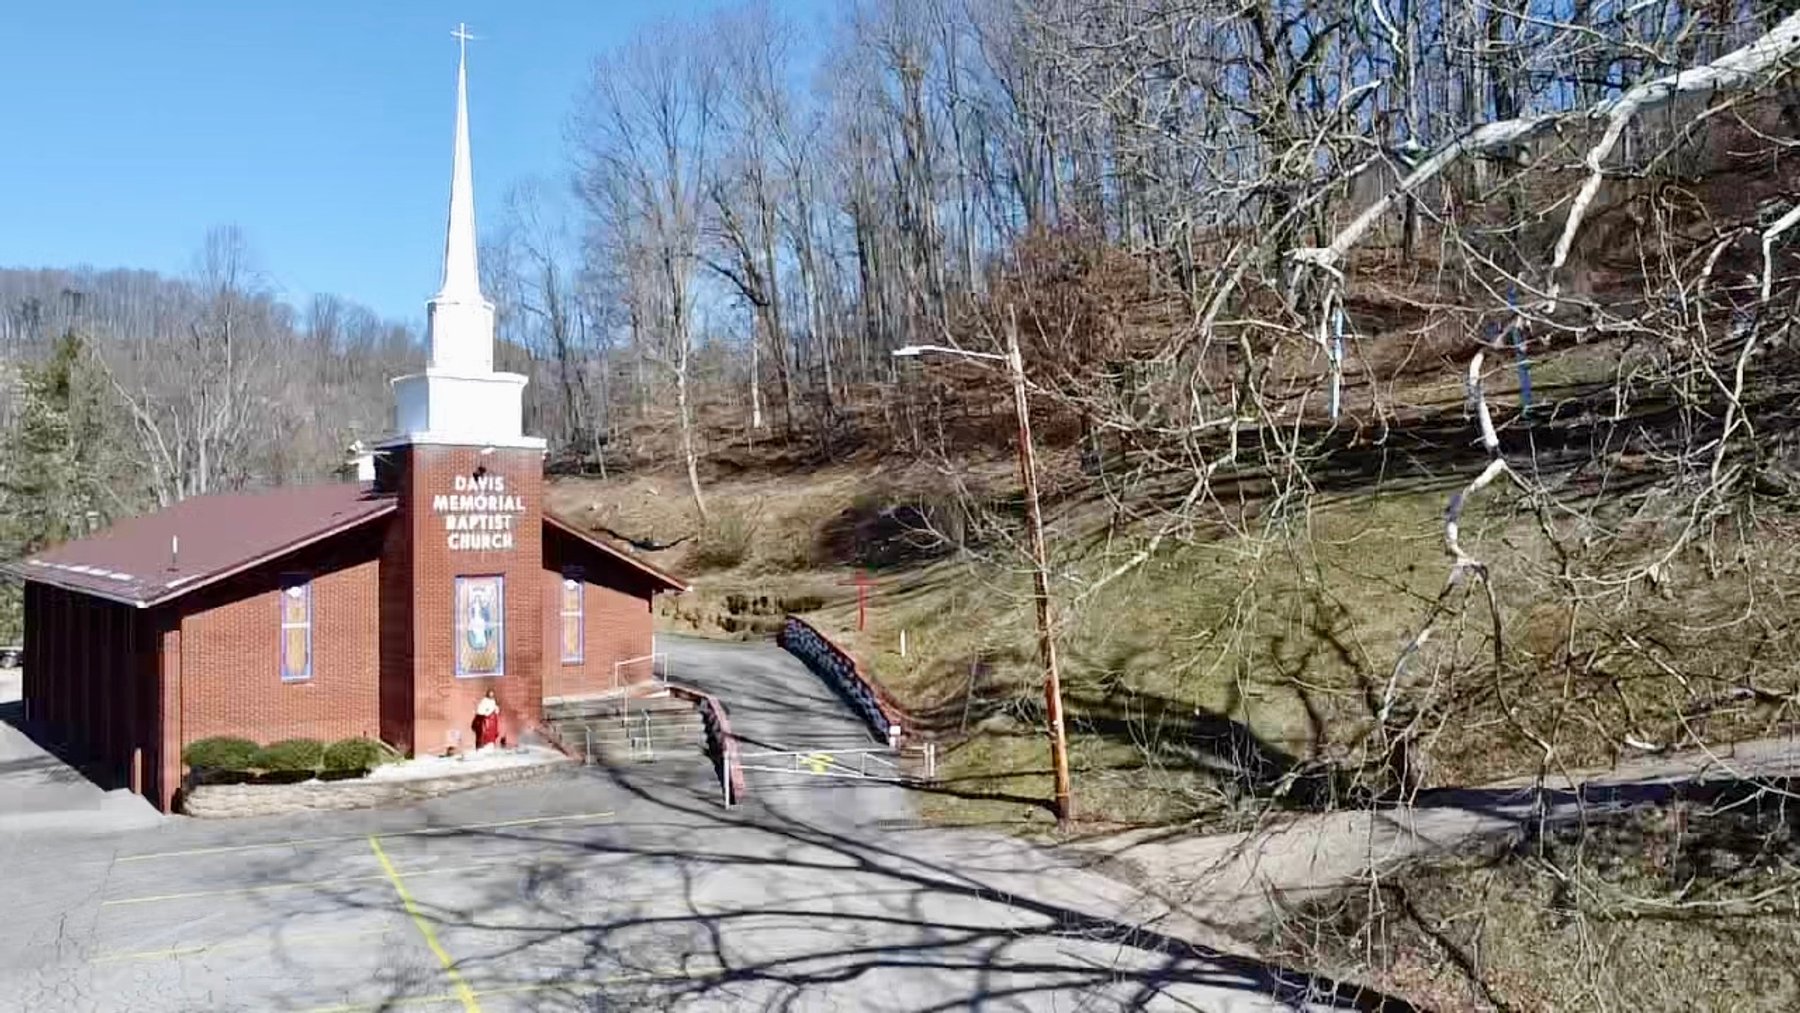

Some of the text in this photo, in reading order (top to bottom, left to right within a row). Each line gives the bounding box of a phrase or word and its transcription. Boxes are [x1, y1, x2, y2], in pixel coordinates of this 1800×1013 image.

[455, 475, 504, 491] DAVIS
[433, 495, 525, 511] MEMORIAL
[446, 514, 512, 530] BAPTIST
[447, 533, 513, 550] CHURCH
